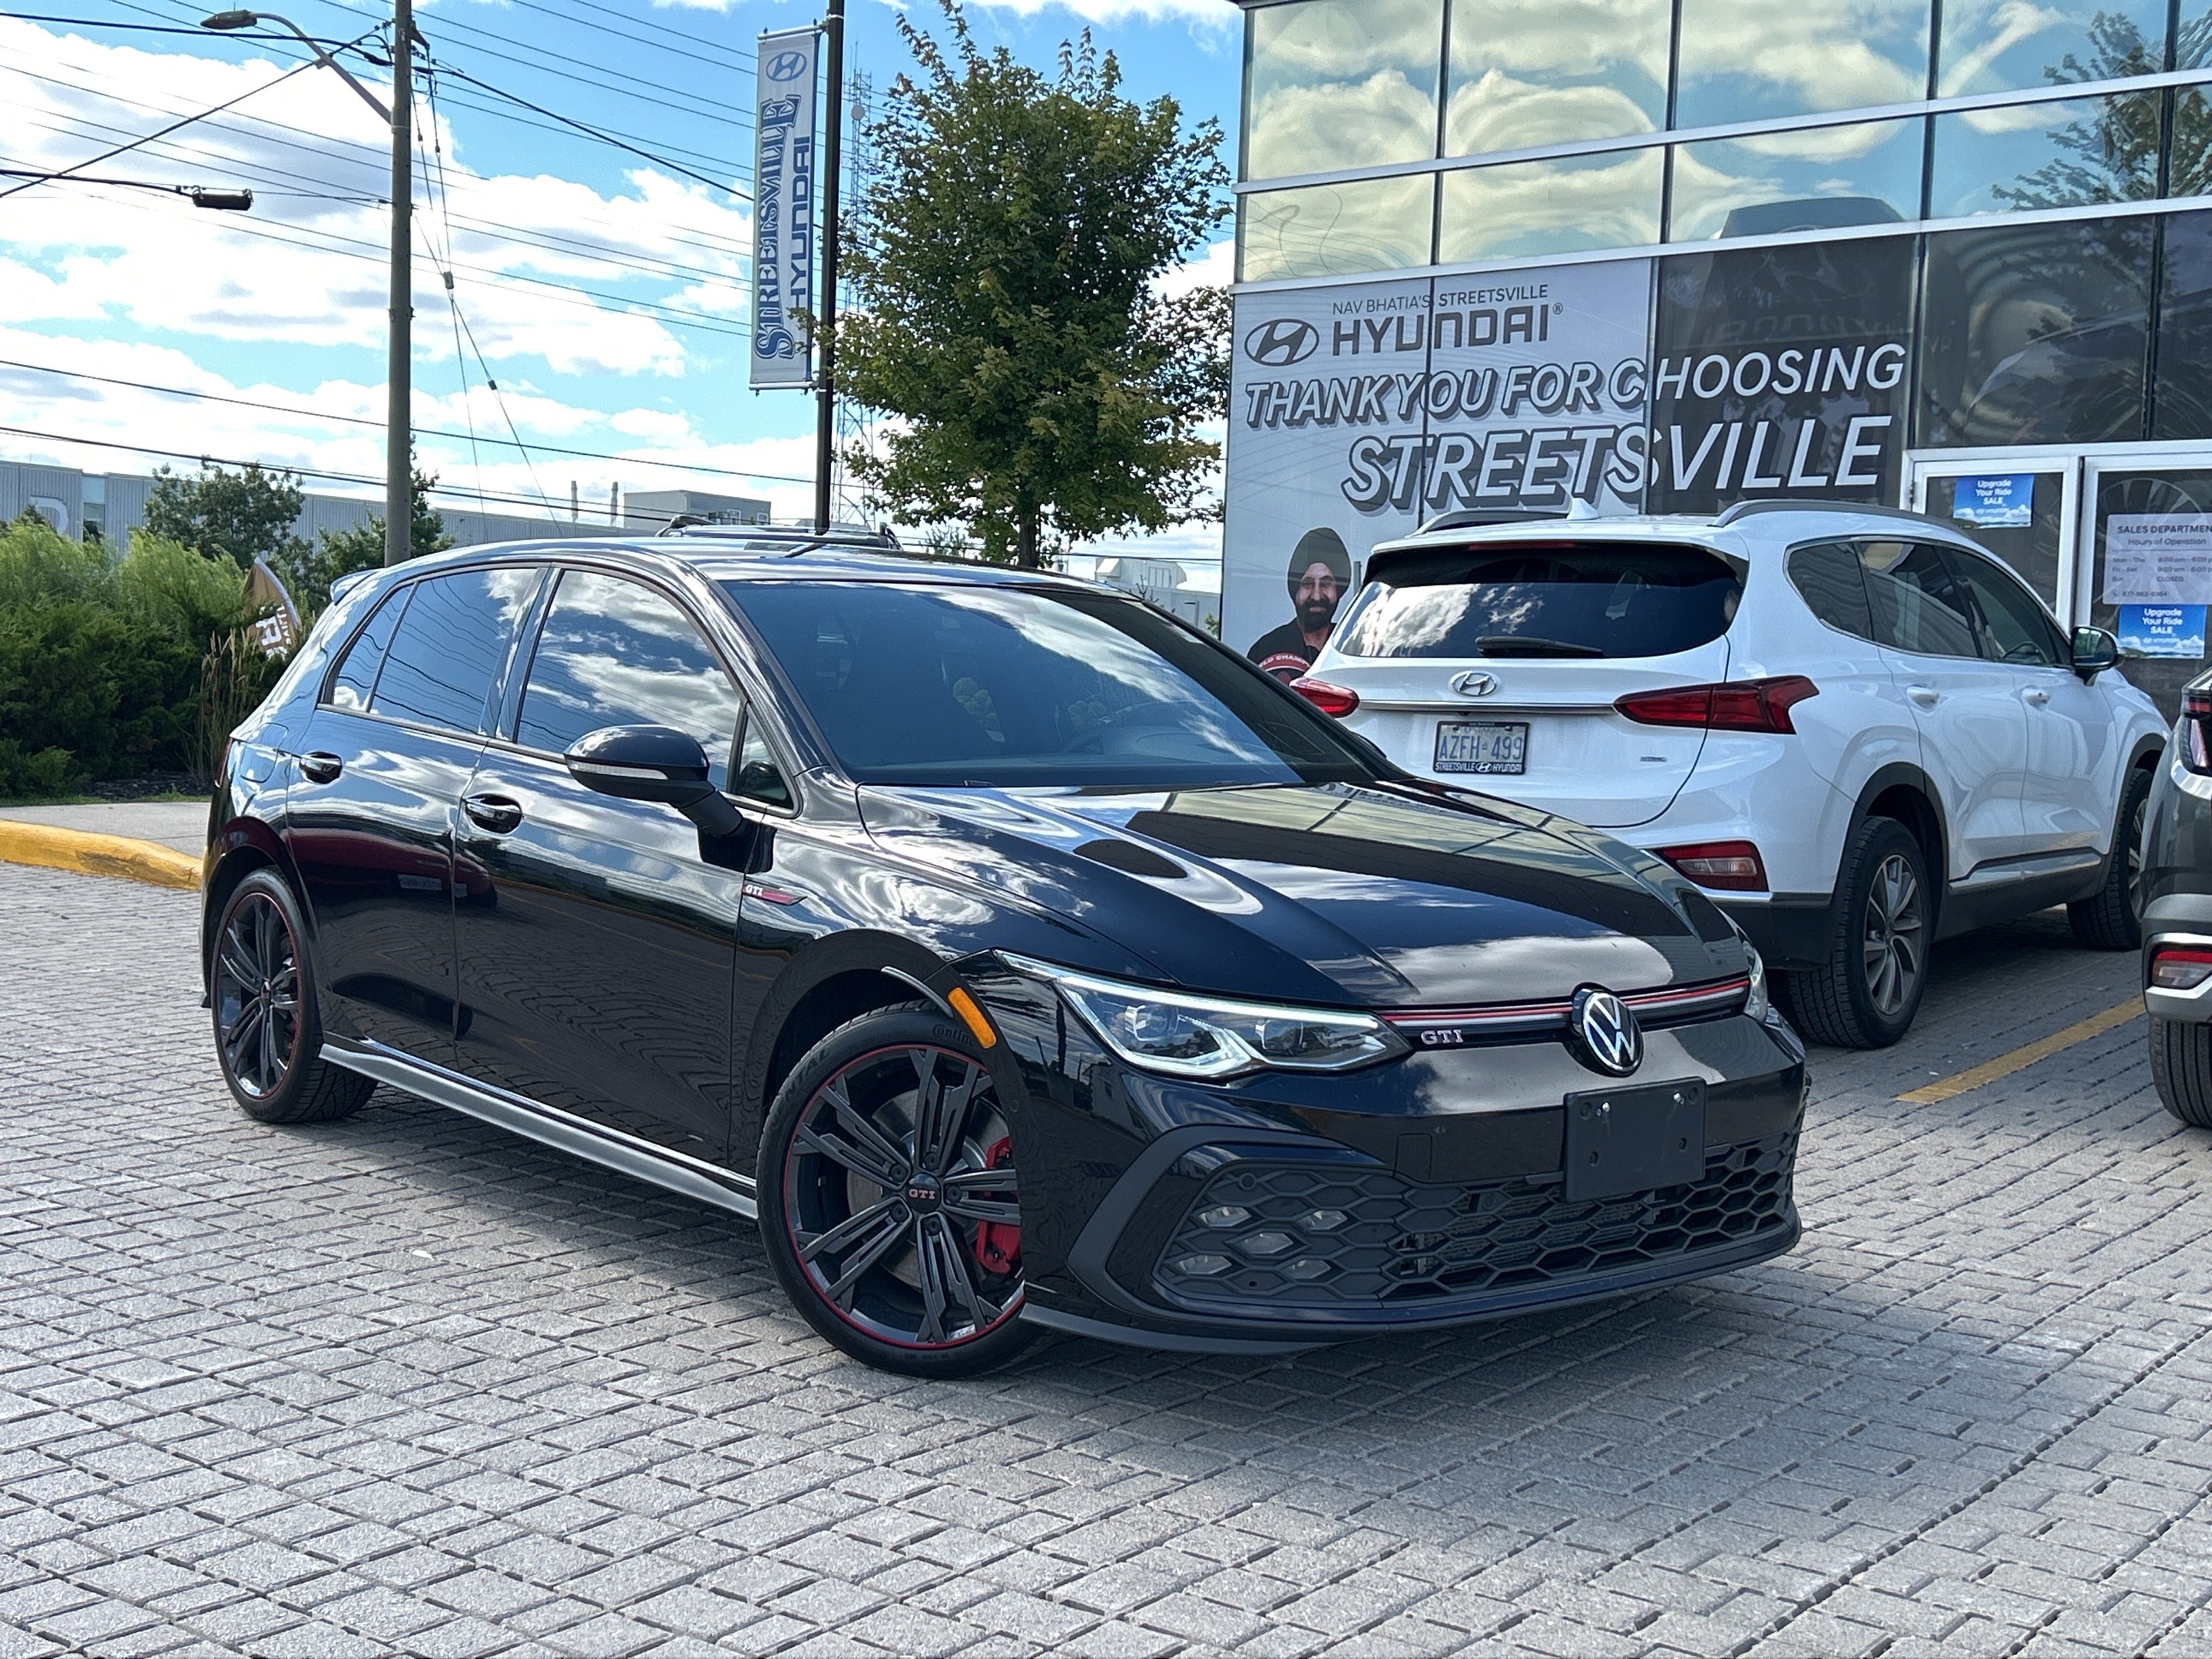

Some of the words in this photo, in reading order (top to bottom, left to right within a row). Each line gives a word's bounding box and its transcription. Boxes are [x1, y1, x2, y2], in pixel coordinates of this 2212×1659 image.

[754, 94, 801, 359] STREETSVILLE
[1333, 300, 1363, 315] NAV
[1366, 295, 1432, 313] BHATIA'S
[1438, 284, 1548, 306] STREETSVILLE
[1332, 303, 1549, 356] HYUNDAI
[1246, 374, 1393, 429] THANK
[1396, 368, 1498, 421] YOU
[1502, 362, 1605, 417] FOR
[1608, 343, 1907, 412] CHOOSING
[1341, 415, 1893, 513] STREETSVILLE
[1977, 479, 2012, 488] Upgrade
[1983, 496, 2003, 505] SALE
[2118, 525, 2148, 534] SALES
[2164, 538, 2207, 546] Operation
[2144, 608, 2182, 618] Upgrade
[2142, 617, 2162, 625] Your
[2163, 617, 2183, 625] Ride
[2151, 626, 2173, 634] SALE
[1439, 736, 1482, 760] AZFH
[1491, 736, 1524, 760] 499
[1435, 762, 1475, 772] STREETSVILLE
[1492, 763, 1522, 773] HYUNDAI
[745, 884, 763, 896] GTI
[1421, 1029, 1464, 1045] GTI
[908, 1188, 936, 1200] GTI
